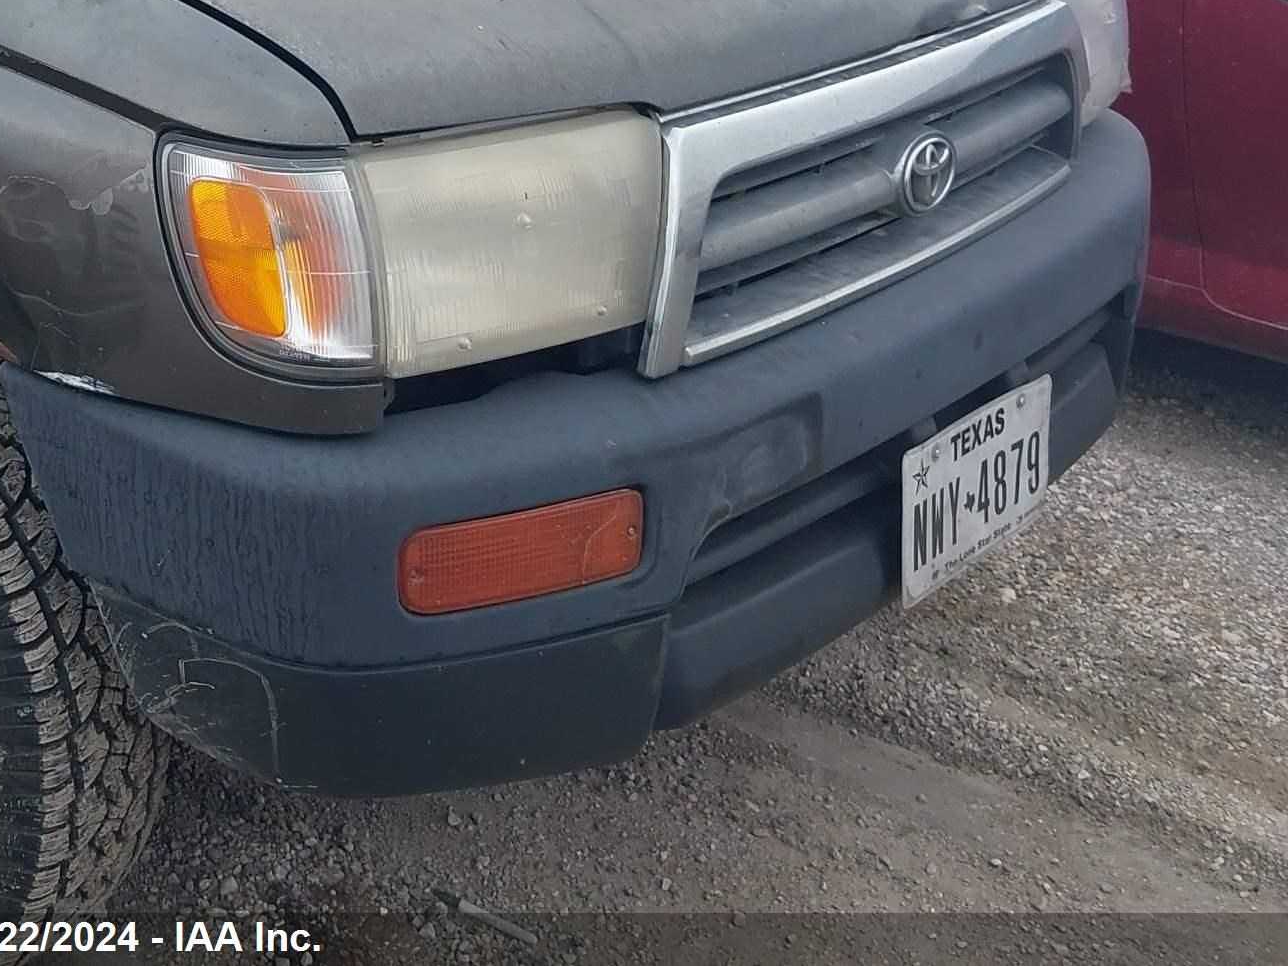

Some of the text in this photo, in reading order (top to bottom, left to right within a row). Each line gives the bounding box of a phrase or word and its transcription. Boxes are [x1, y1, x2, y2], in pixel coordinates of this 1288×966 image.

[950, 407, 1006, 462] TEXAS
[959, 545, 976, 562] Lone
[977, 534, 992, 550] Star
